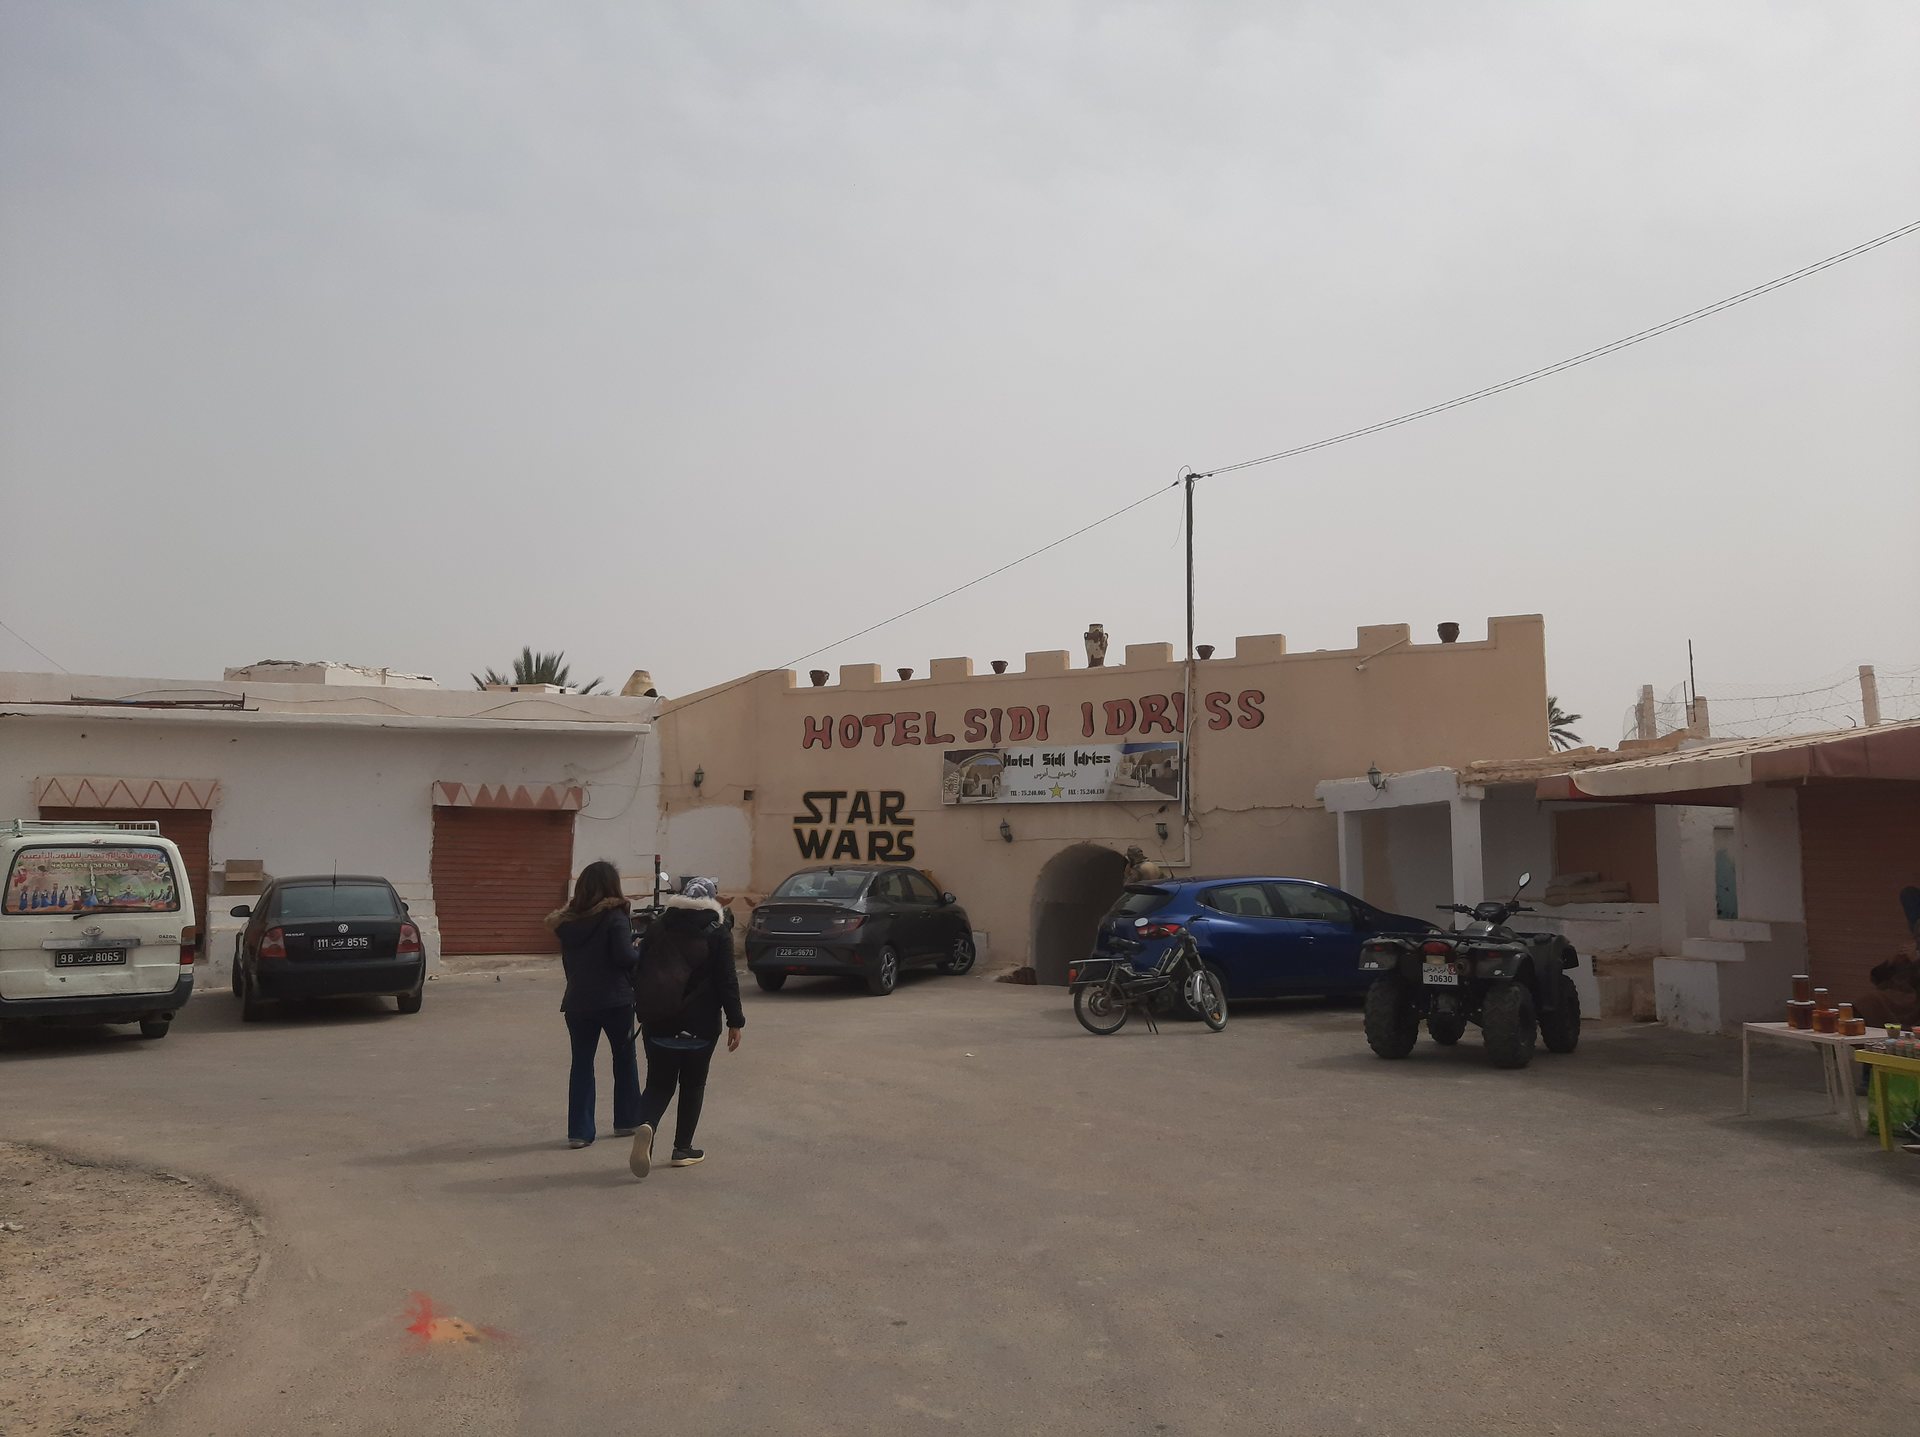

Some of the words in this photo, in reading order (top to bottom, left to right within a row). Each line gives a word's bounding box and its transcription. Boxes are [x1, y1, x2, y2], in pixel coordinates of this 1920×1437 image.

[802, 711, 955, 749] HOTEL
[964, 705, 1050, 743] SIDI
[1003, 753, 1034, 767] Hotel
[1042, 752, 1066, 767] Sidi
[1074, 750, 1111, 766] Idriss
[793, 790, 915, 825] STAR
[793, 828, 915, 861] WARS
[317, 938, 328, 948] 111
[347, 937, 368, 947] 8515
[60, 953, 74, 963] 98
[95, 951, 119, 962] 8065
[1429, 975, 1453, 983] 30630
